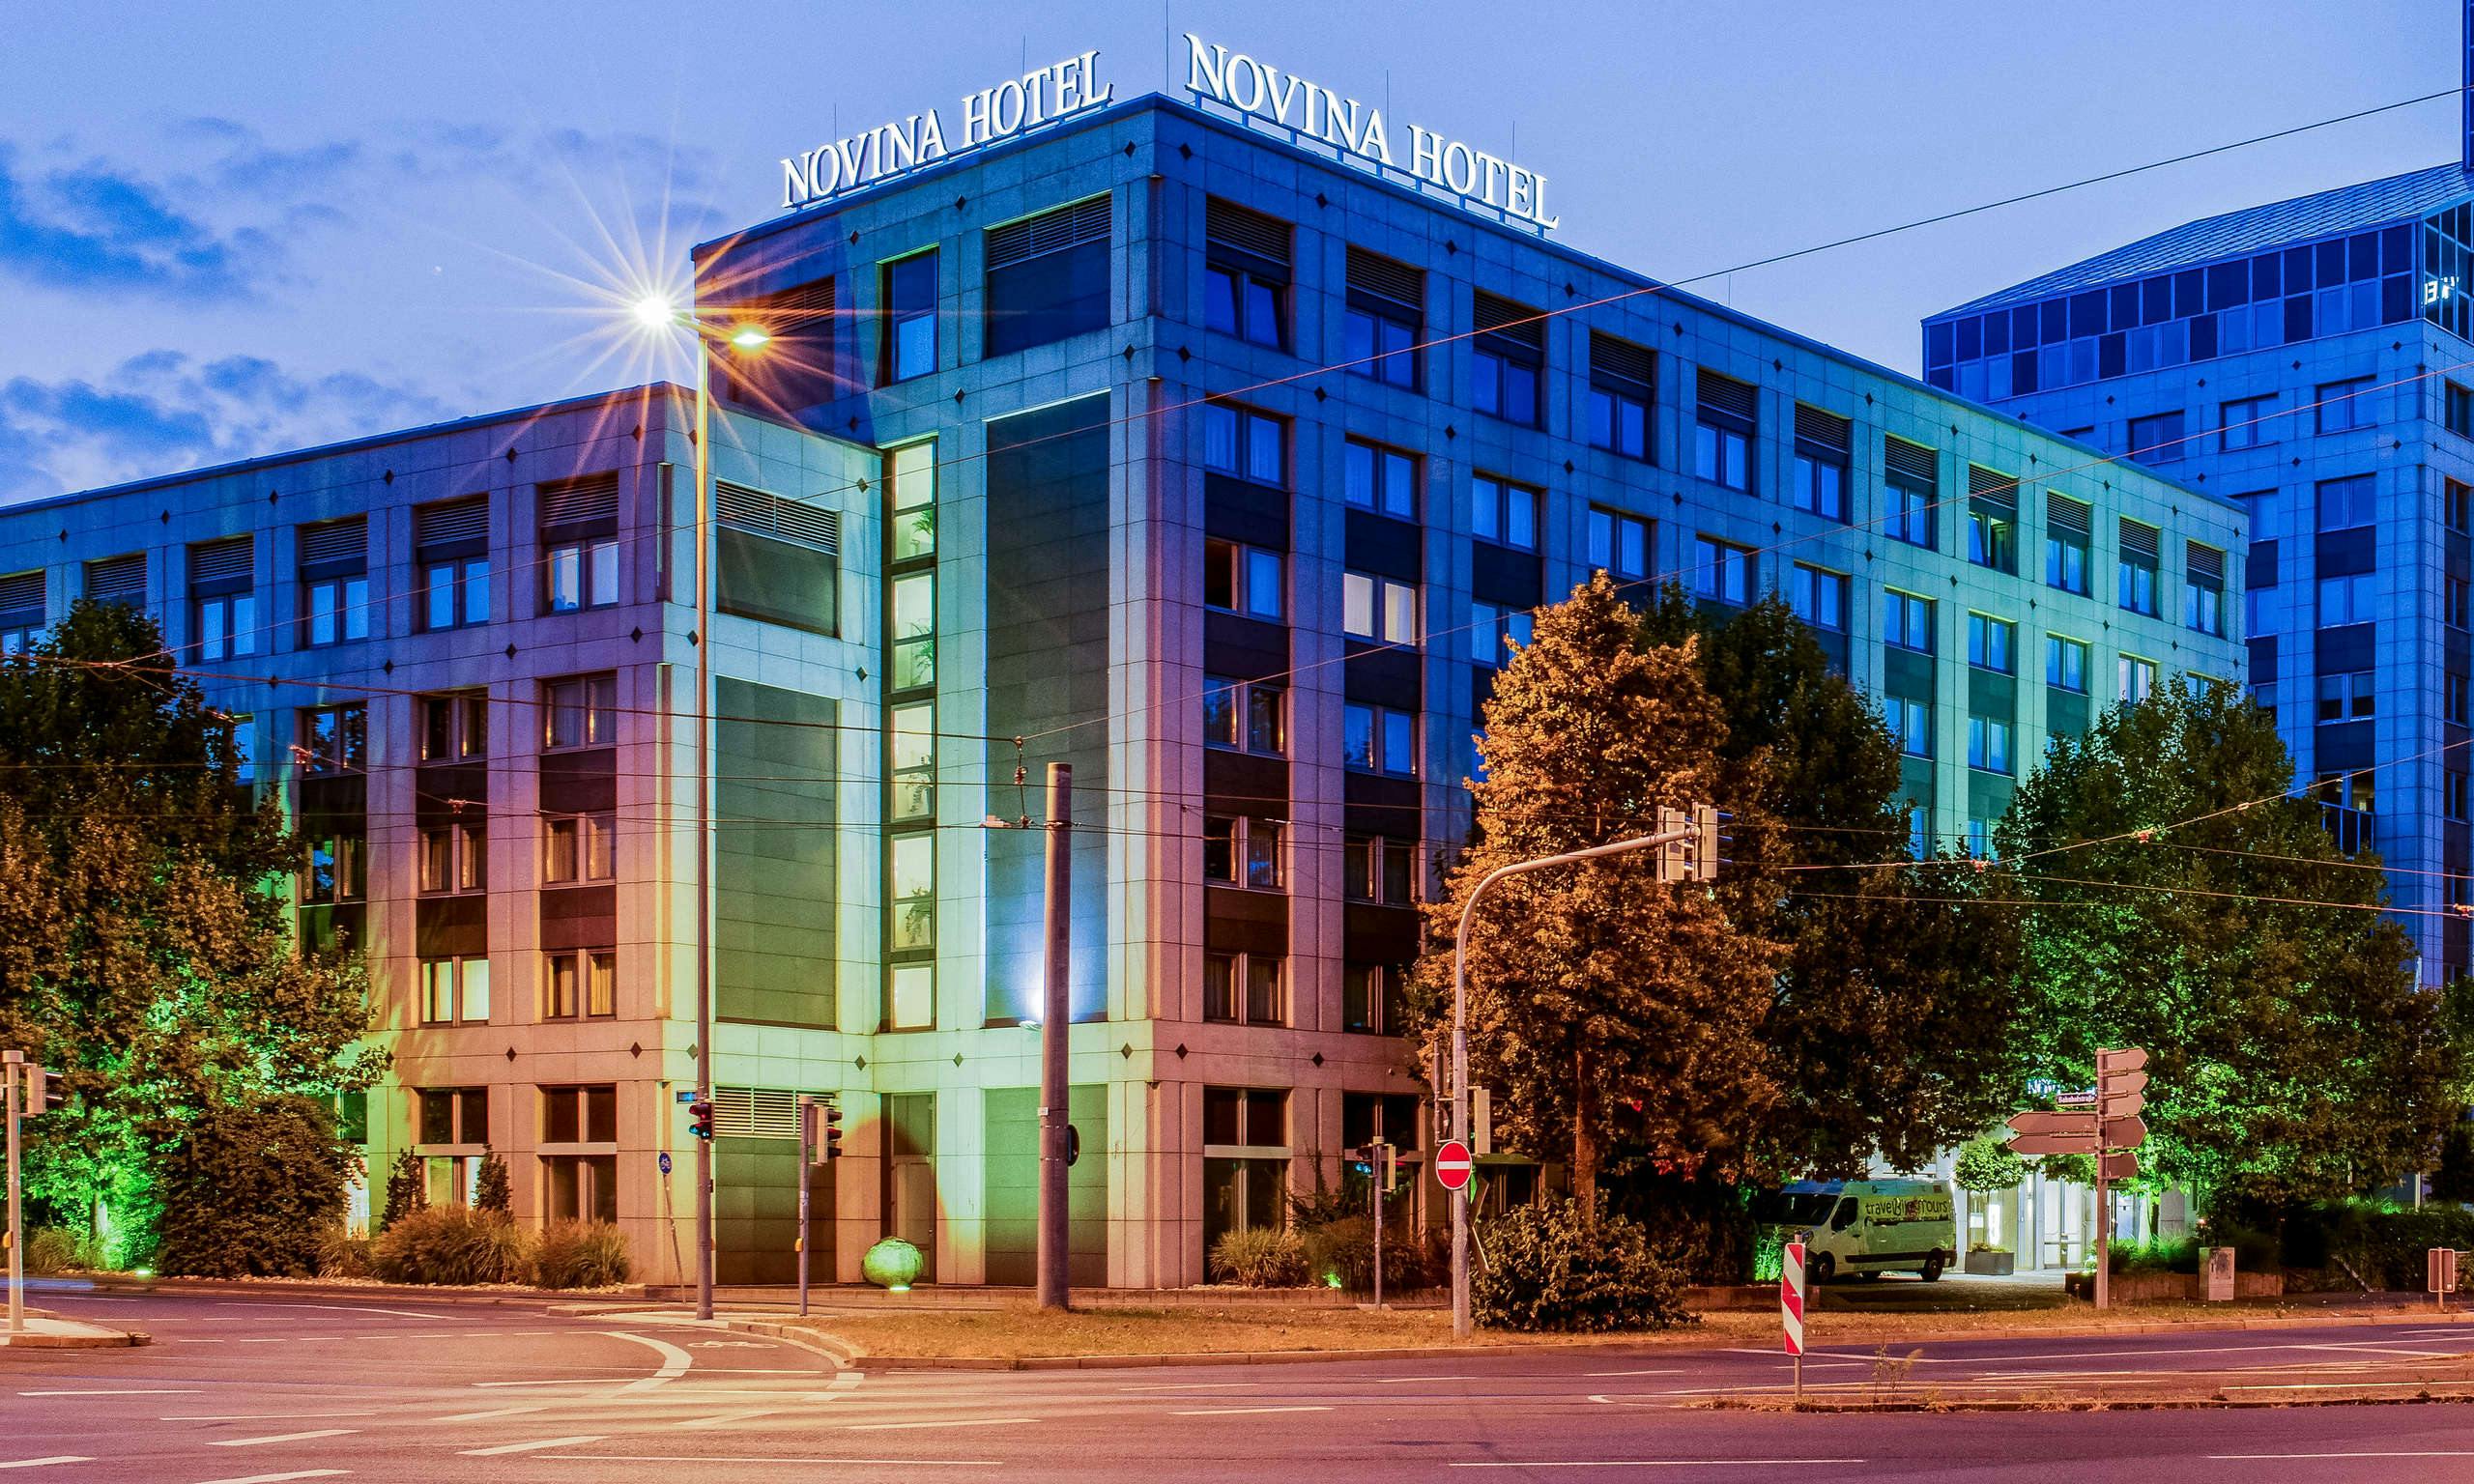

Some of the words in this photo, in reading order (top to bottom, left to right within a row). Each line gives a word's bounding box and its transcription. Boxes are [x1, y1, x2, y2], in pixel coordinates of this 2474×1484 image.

[780, 107, 950, 208] NOVINA
[962, 49, 1113, 149] HOTEL
[1183, 32, 1395, 167] NOVINA
[1408, 124, 1559, 230] HOTEL
